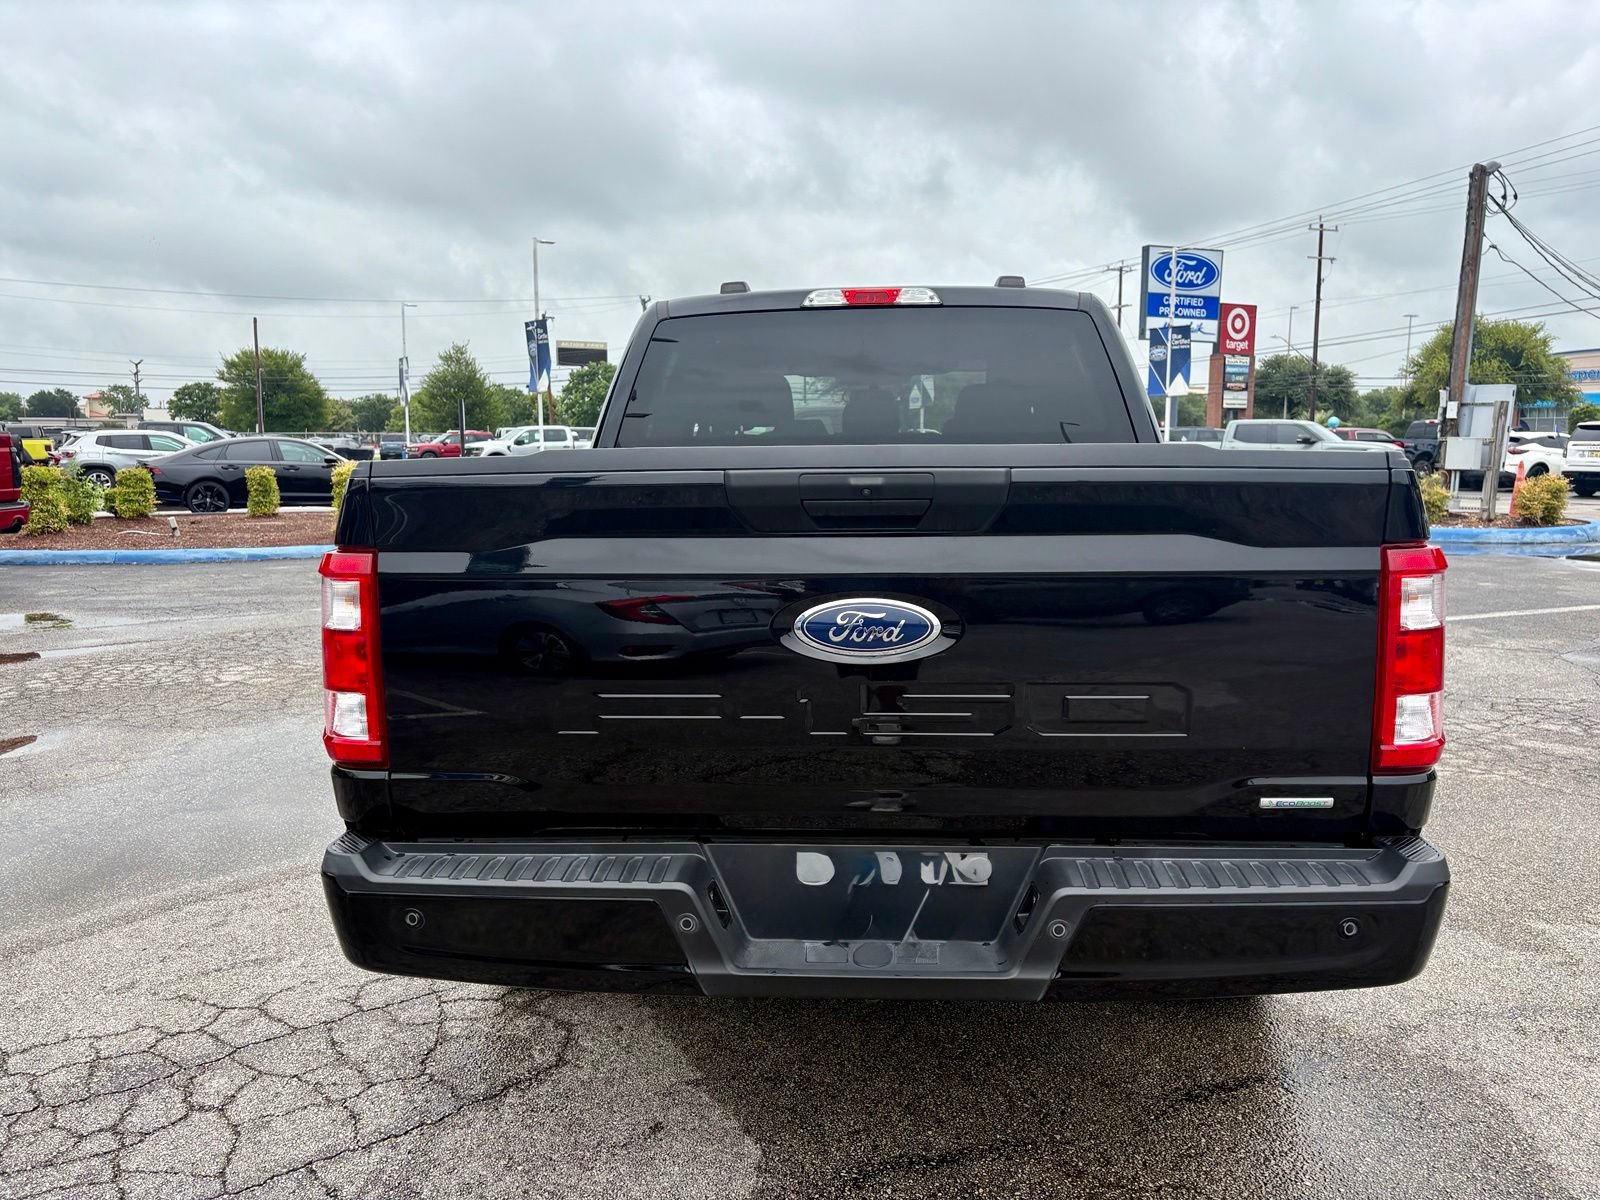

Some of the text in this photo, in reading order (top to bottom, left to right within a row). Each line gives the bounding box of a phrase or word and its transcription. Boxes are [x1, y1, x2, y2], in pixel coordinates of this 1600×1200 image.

[1163, 257, 1207, 285] Ford
[1163, 295, 1204, 307] CRTIFIED
[1158, 306, 1207, 318] PR-OWNED
[1226, 339, 1249, 352] target
[826, 609, 907, 644] Ford
